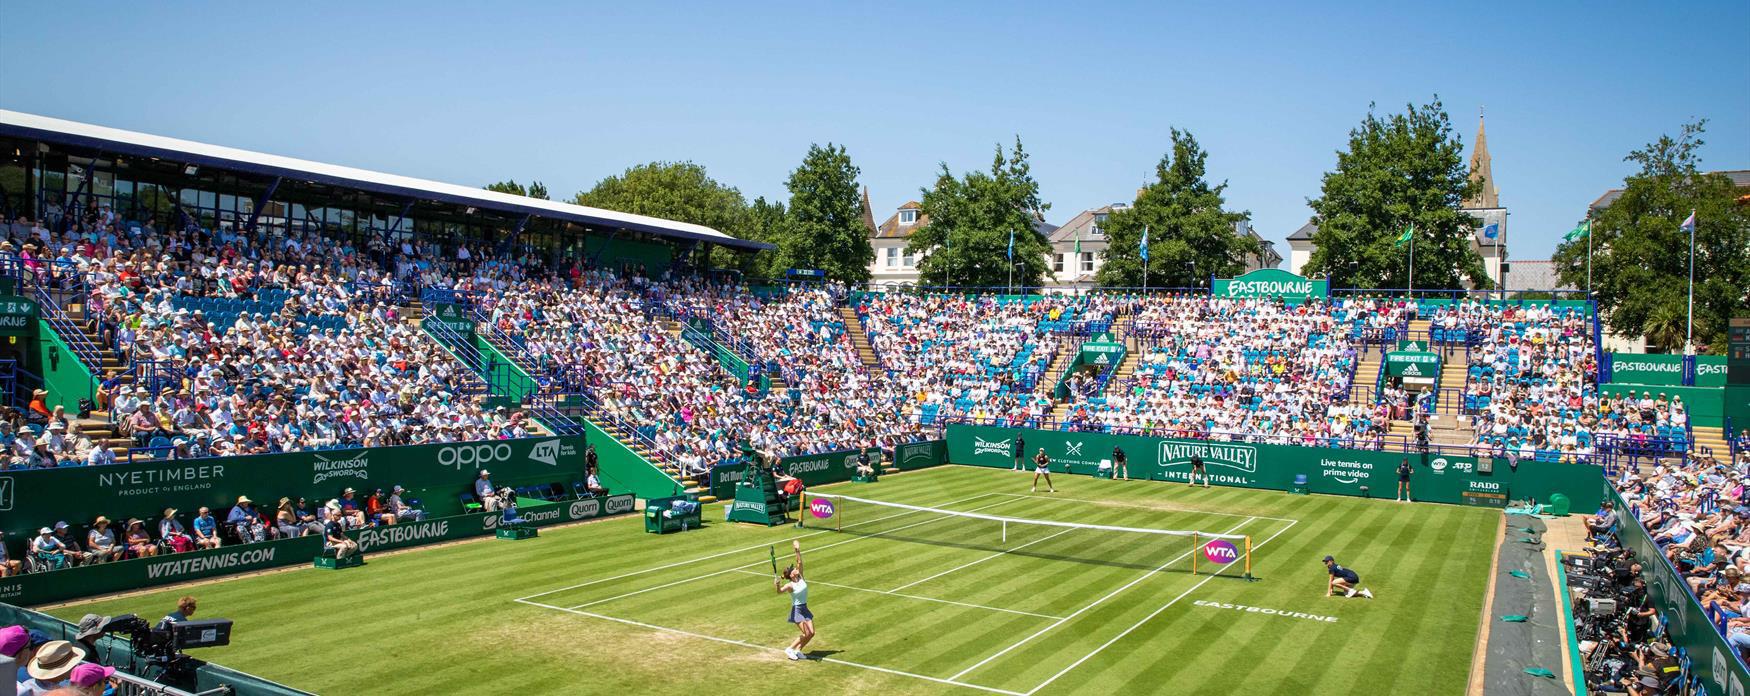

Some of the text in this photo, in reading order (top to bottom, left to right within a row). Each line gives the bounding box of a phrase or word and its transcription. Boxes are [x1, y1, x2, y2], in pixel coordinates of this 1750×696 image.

[1227, 281, 1313, 296] EASTBOURNE
[1613, 361, 1680, 372] EASTBOURNE
[974, 441, 1010, 449] WILKINSON
[438, 443, 511, 470] oppo
[536, 446, 557, 460] LTA
[1163, 443, 1253, 468] NATURE VALLEY
[313, 459, 368, 470] WILKINSON
[789, 459, 829, 476] EASTBOURNE
[1338, 460, 1361, 468] tennis
[99, 465, 224, 487] NYETIMBER
[329, 469, 353, 477] SWORD
[1323, 468, 1369, 478] prime video
[118, 487, 159, 496] PRODUCT
[173, 483, 212, 492] ENGLAND
[1470, 481, 1499, 490] RADO
[572, 502, 597, 515] Quorn
[607, 499, 632, 510] Quorn
[811, 504, 832, 514] WTA
[525, 507, 560, 522] Channel
[357, 520, 448, 552] EASTBOURNE
[1206, 546, 1236, 558] WTA
[147, 547, 276, 579] WTATENNIS.COM
[1193, 600, 1339, 623] EASTBOURNE
